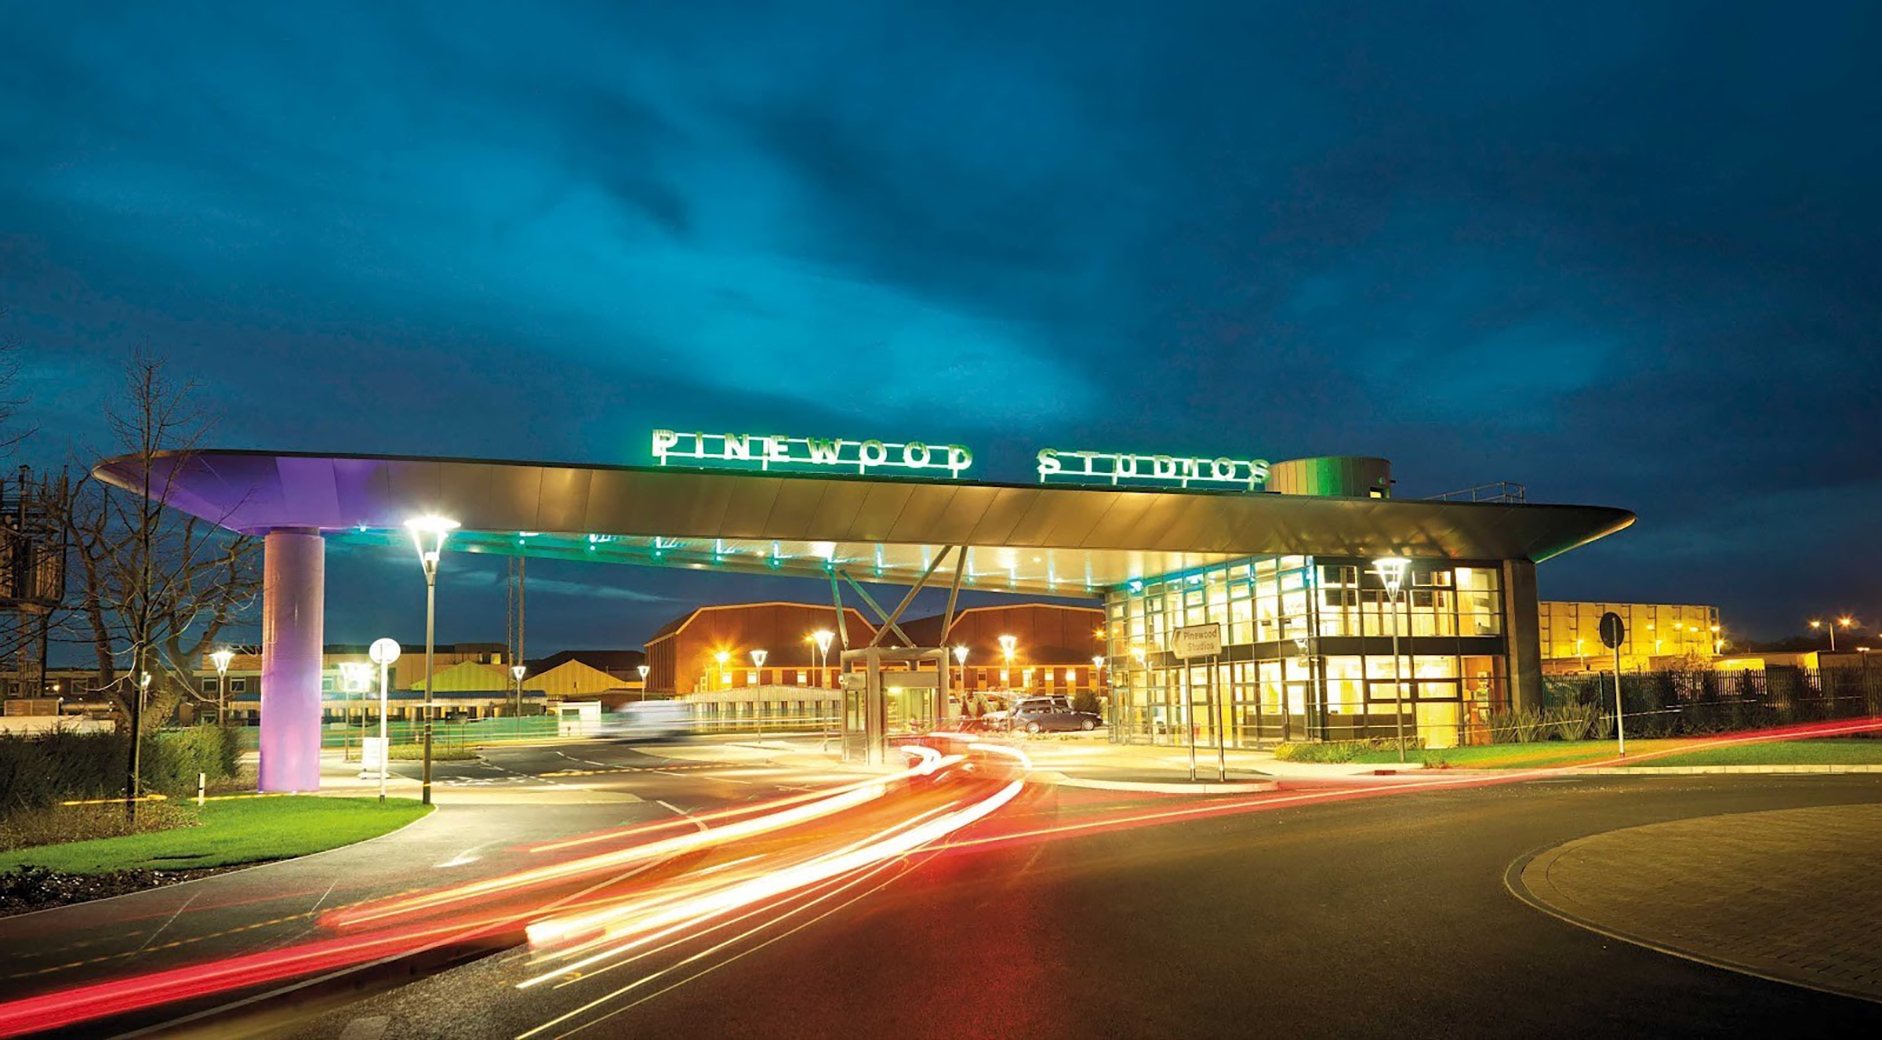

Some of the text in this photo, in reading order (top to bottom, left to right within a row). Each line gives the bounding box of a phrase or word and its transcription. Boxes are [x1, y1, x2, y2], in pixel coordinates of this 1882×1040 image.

[652, 429, 1271, 483] PINEWOOD STUDIOS
[1184, 629, 1217, 640] Pinewood
[1187, 640, 1214, 651] Studios
